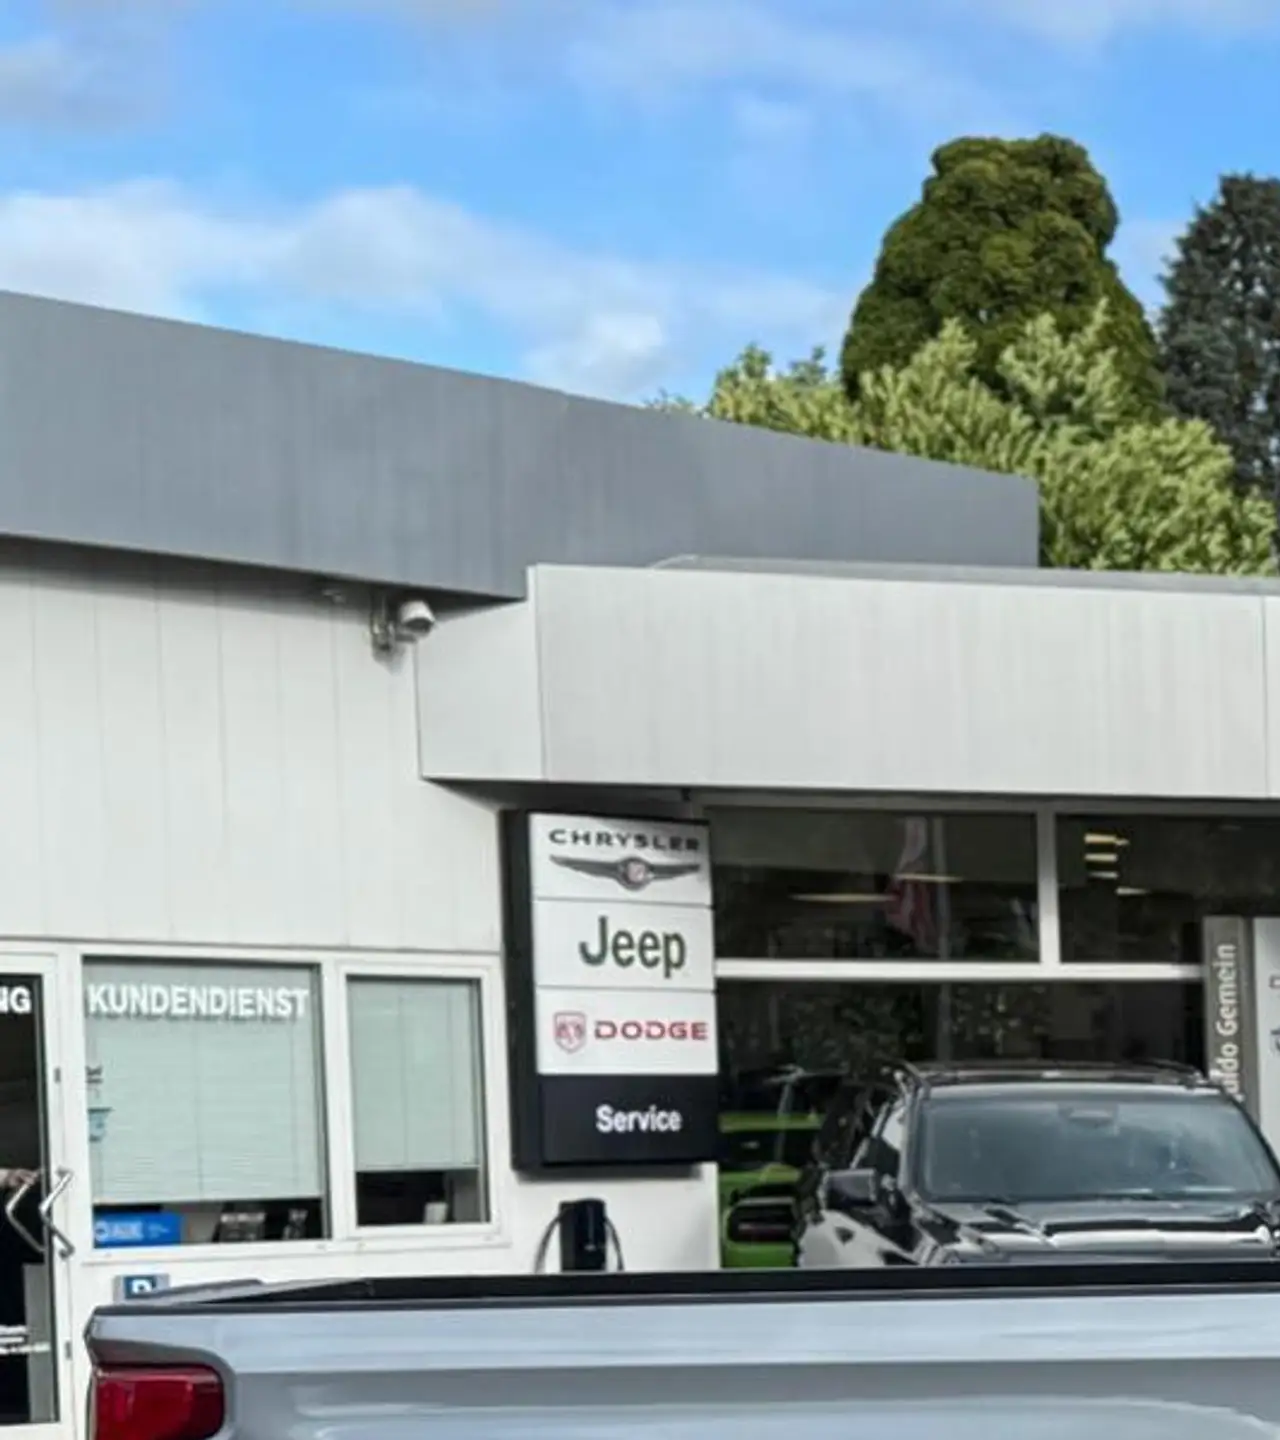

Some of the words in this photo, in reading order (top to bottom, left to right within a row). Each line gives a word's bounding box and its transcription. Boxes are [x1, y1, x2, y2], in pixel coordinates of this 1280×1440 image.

[548, 828, 700, 851] CHRYSLER
[578, 914, 688, 980] Jeep
[86, 983, 310, 1018] KUNDENDIENST
[1213, 943, 1238, 1037] Gemein
[594, 1020, 708, 1041] DODGE
[595, 1104, 683, 1134] Service
